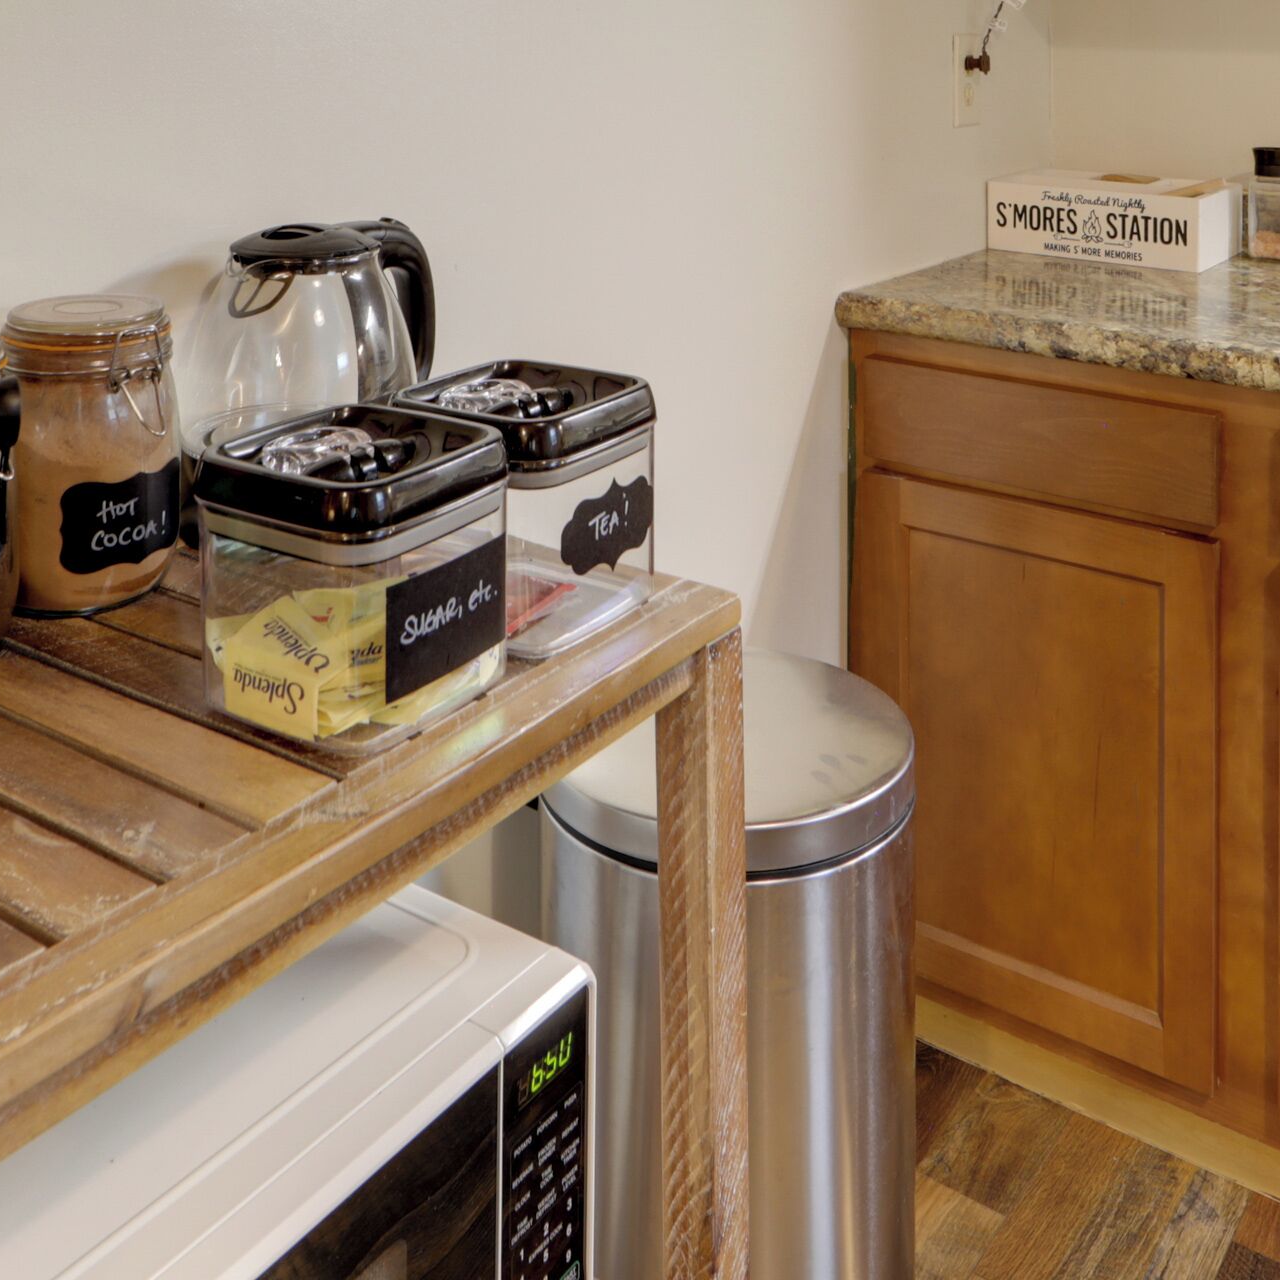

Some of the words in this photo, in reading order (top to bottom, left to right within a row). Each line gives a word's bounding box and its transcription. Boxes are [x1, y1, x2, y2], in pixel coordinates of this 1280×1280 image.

[996, 202, 1078, 235] S'MORES
[1106, 212, 1188, 247] STATION
[1041, 191, 1073, 207] Freshly
[1075, 194, 1111, 207] Roasted
[1111, 197, 1146, 213] Nightly
[1044, 242, 1071, 254] MAKING
[1104, 249, 1143, 262] MEMORIES
[91, 510, 166, 552] COCOA!
[588, 493, 631, 540] TEA!
[400, 596, 463, 645] SUGAR,
[468, 580, 499, 616] etc.
[264, 618, 330, 674] Splenda
[233, 667, 305, 716] Splenda
